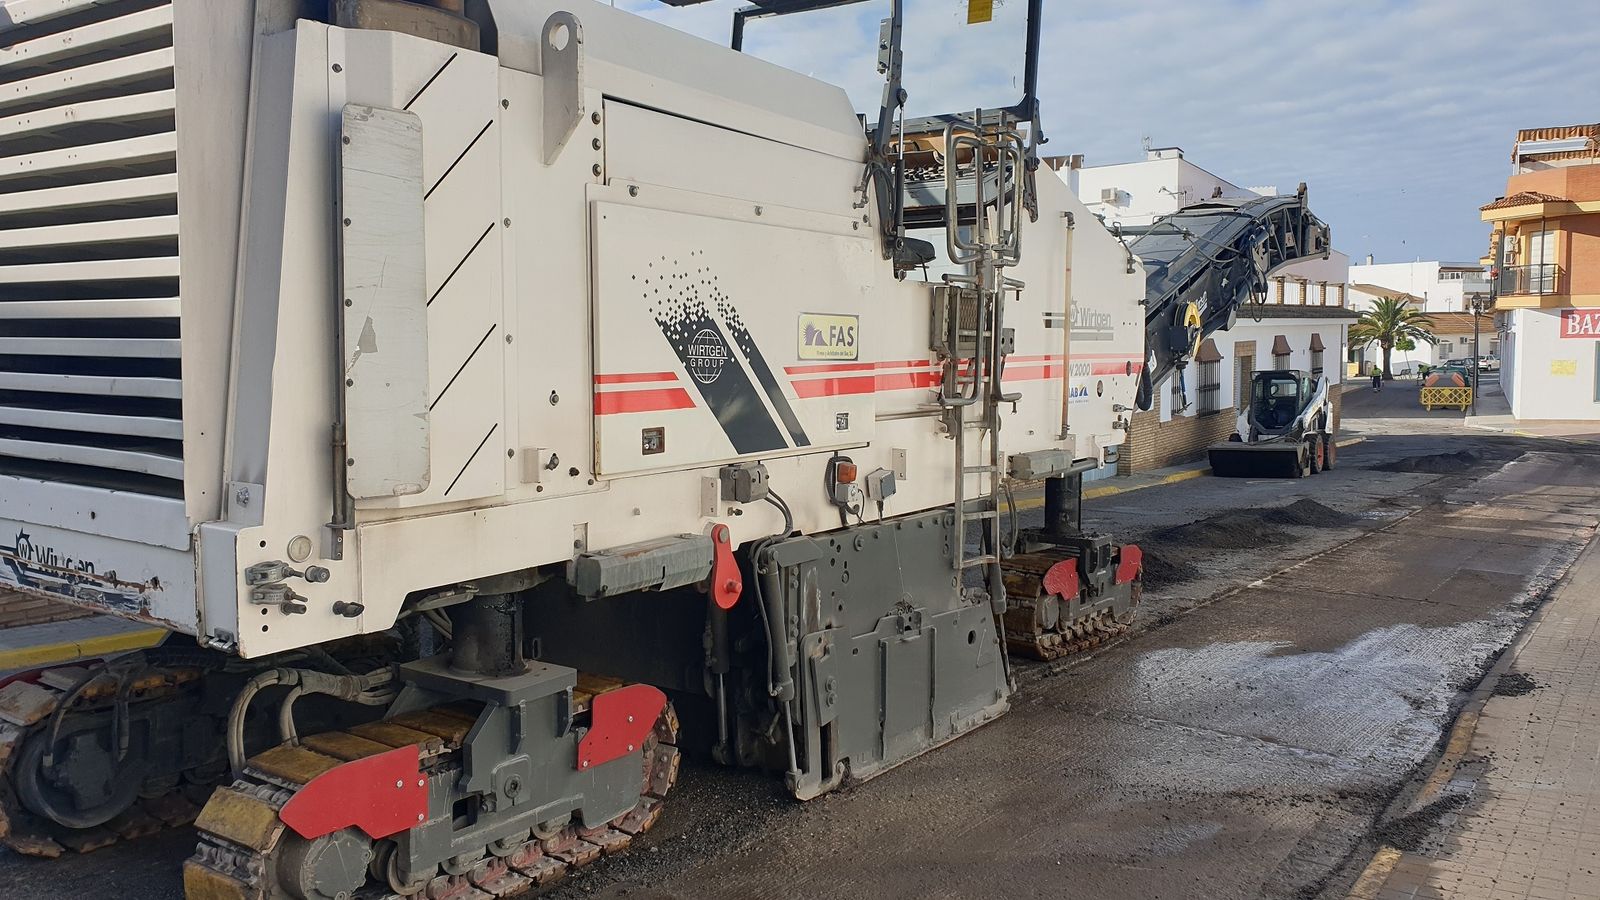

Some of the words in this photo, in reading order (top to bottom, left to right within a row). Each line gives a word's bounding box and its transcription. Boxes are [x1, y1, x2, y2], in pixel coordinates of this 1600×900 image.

[1080, 307, 1111, 331] Wirtgen
[829, 325, 854, 347] FAS
[687, 344, 727, 357] WIRTGEN
[690, 358, 725, 368] GROUP
